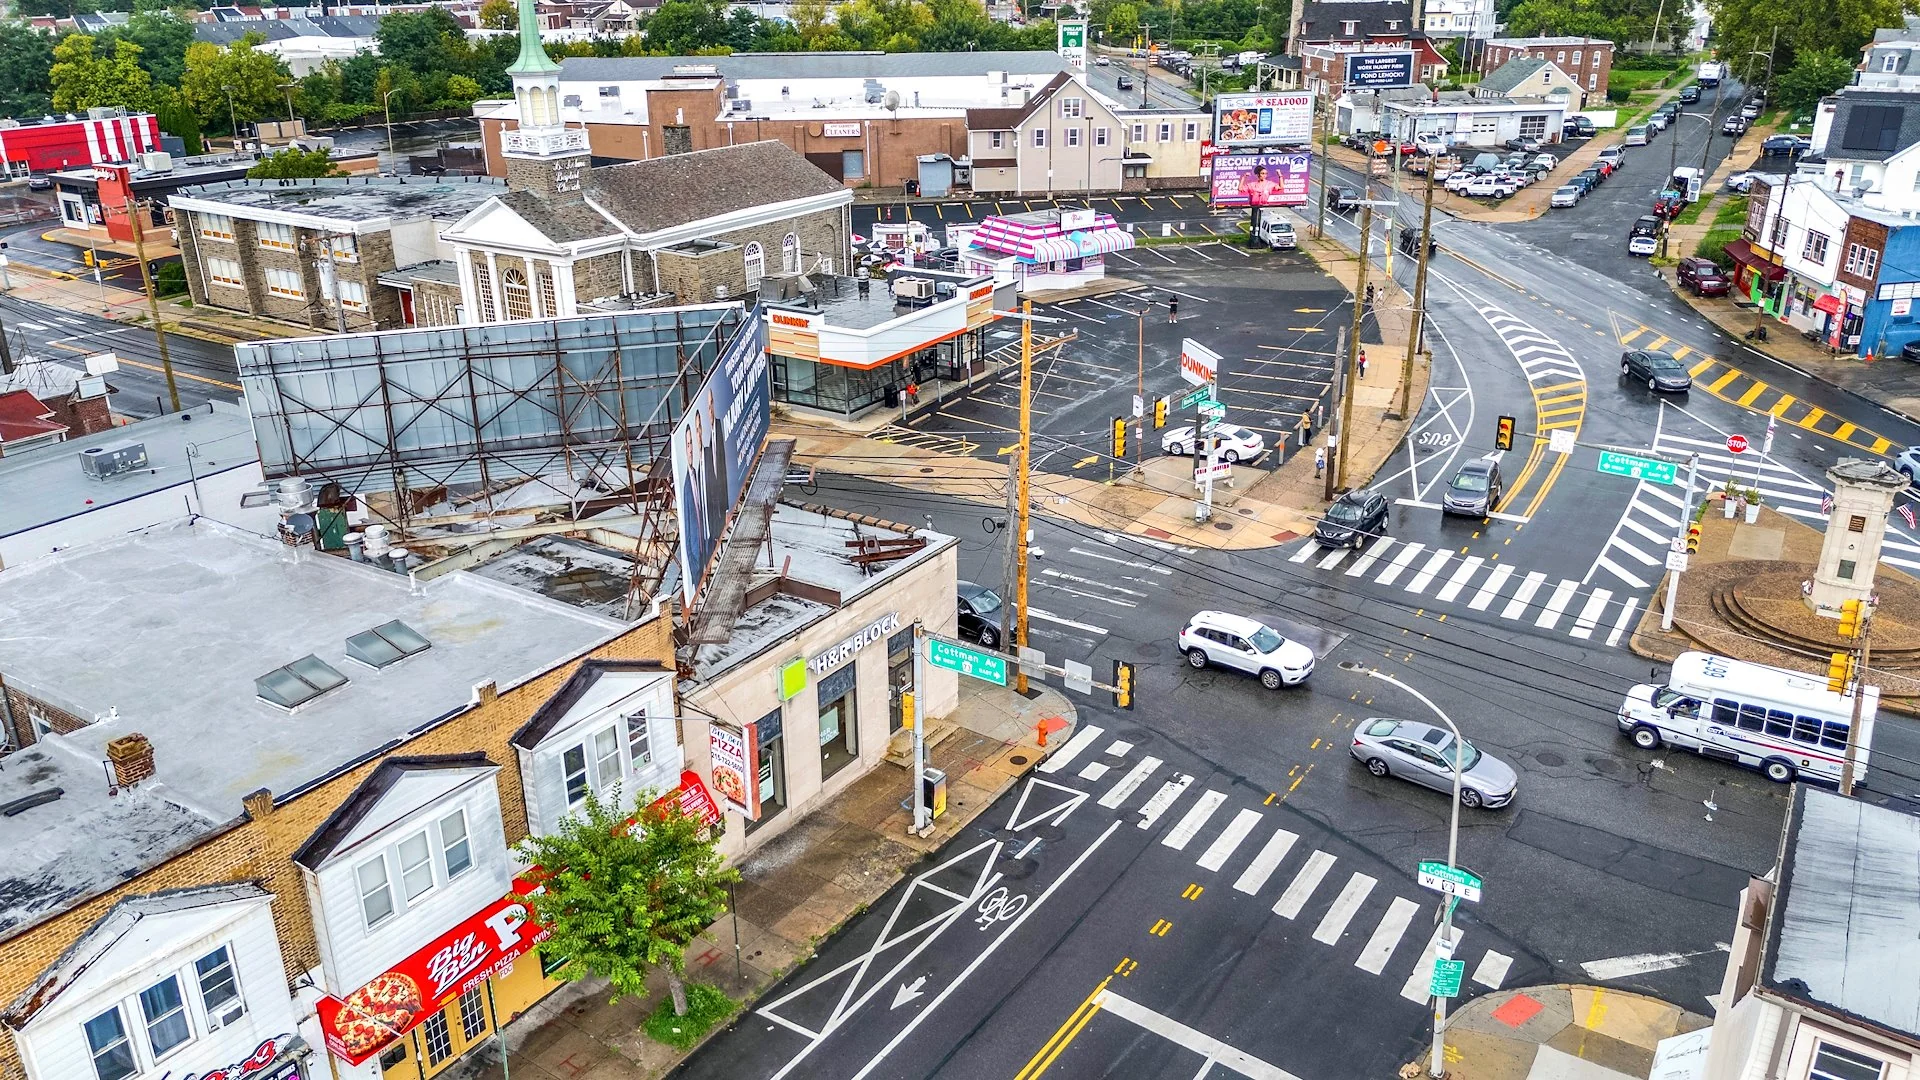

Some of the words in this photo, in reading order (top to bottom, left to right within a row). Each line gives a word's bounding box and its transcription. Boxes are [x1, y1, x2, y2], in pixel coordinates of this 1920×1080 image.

[1266, 98, 1308, 107] SEAFOOD
[1215, 157, 1257, 167] BECOME
[1259, 157, 1267, 166] A
[1268, 156, 1290, 165] CNA
[1214, 180, 1240, 190] $250
[731, 361, 744, 394] YOUR
[723, 385, 744, 442] INJURY
[743, 346, 766, 404] LAWYERS
[1418, 432, 1452, 446] BUS
[1727, 440, 1747, 450] STOP
[1607, 454, 1650, 469] Cottman
[1656, 462, 1668, 473] Av
[816, 643, 852, 675] H&R
[854, 612, 900, 653] BLOCK
[937, 644, 980, 663] Cottman
[985, 658, 997, 668] Av
[711, 727, 724, 740] Big
[710, 736, 743, 760] PIZZA
[683, 797, 704, 814] DELIVERY
[1426, 876, 1434, 885] W
[1444, 882, 1453, 890] 73
[1428, 866, 1465, 884] Cottman
[1469, 879, 1480, 889] Av
[426, 932, 477, 981] Big
[434, 940, 487, 994] Ben
[462, 968, 494, 992] FRESH
[494, 948, 521, 972] PIZZA
[500, 963, 513, 978] FDC
